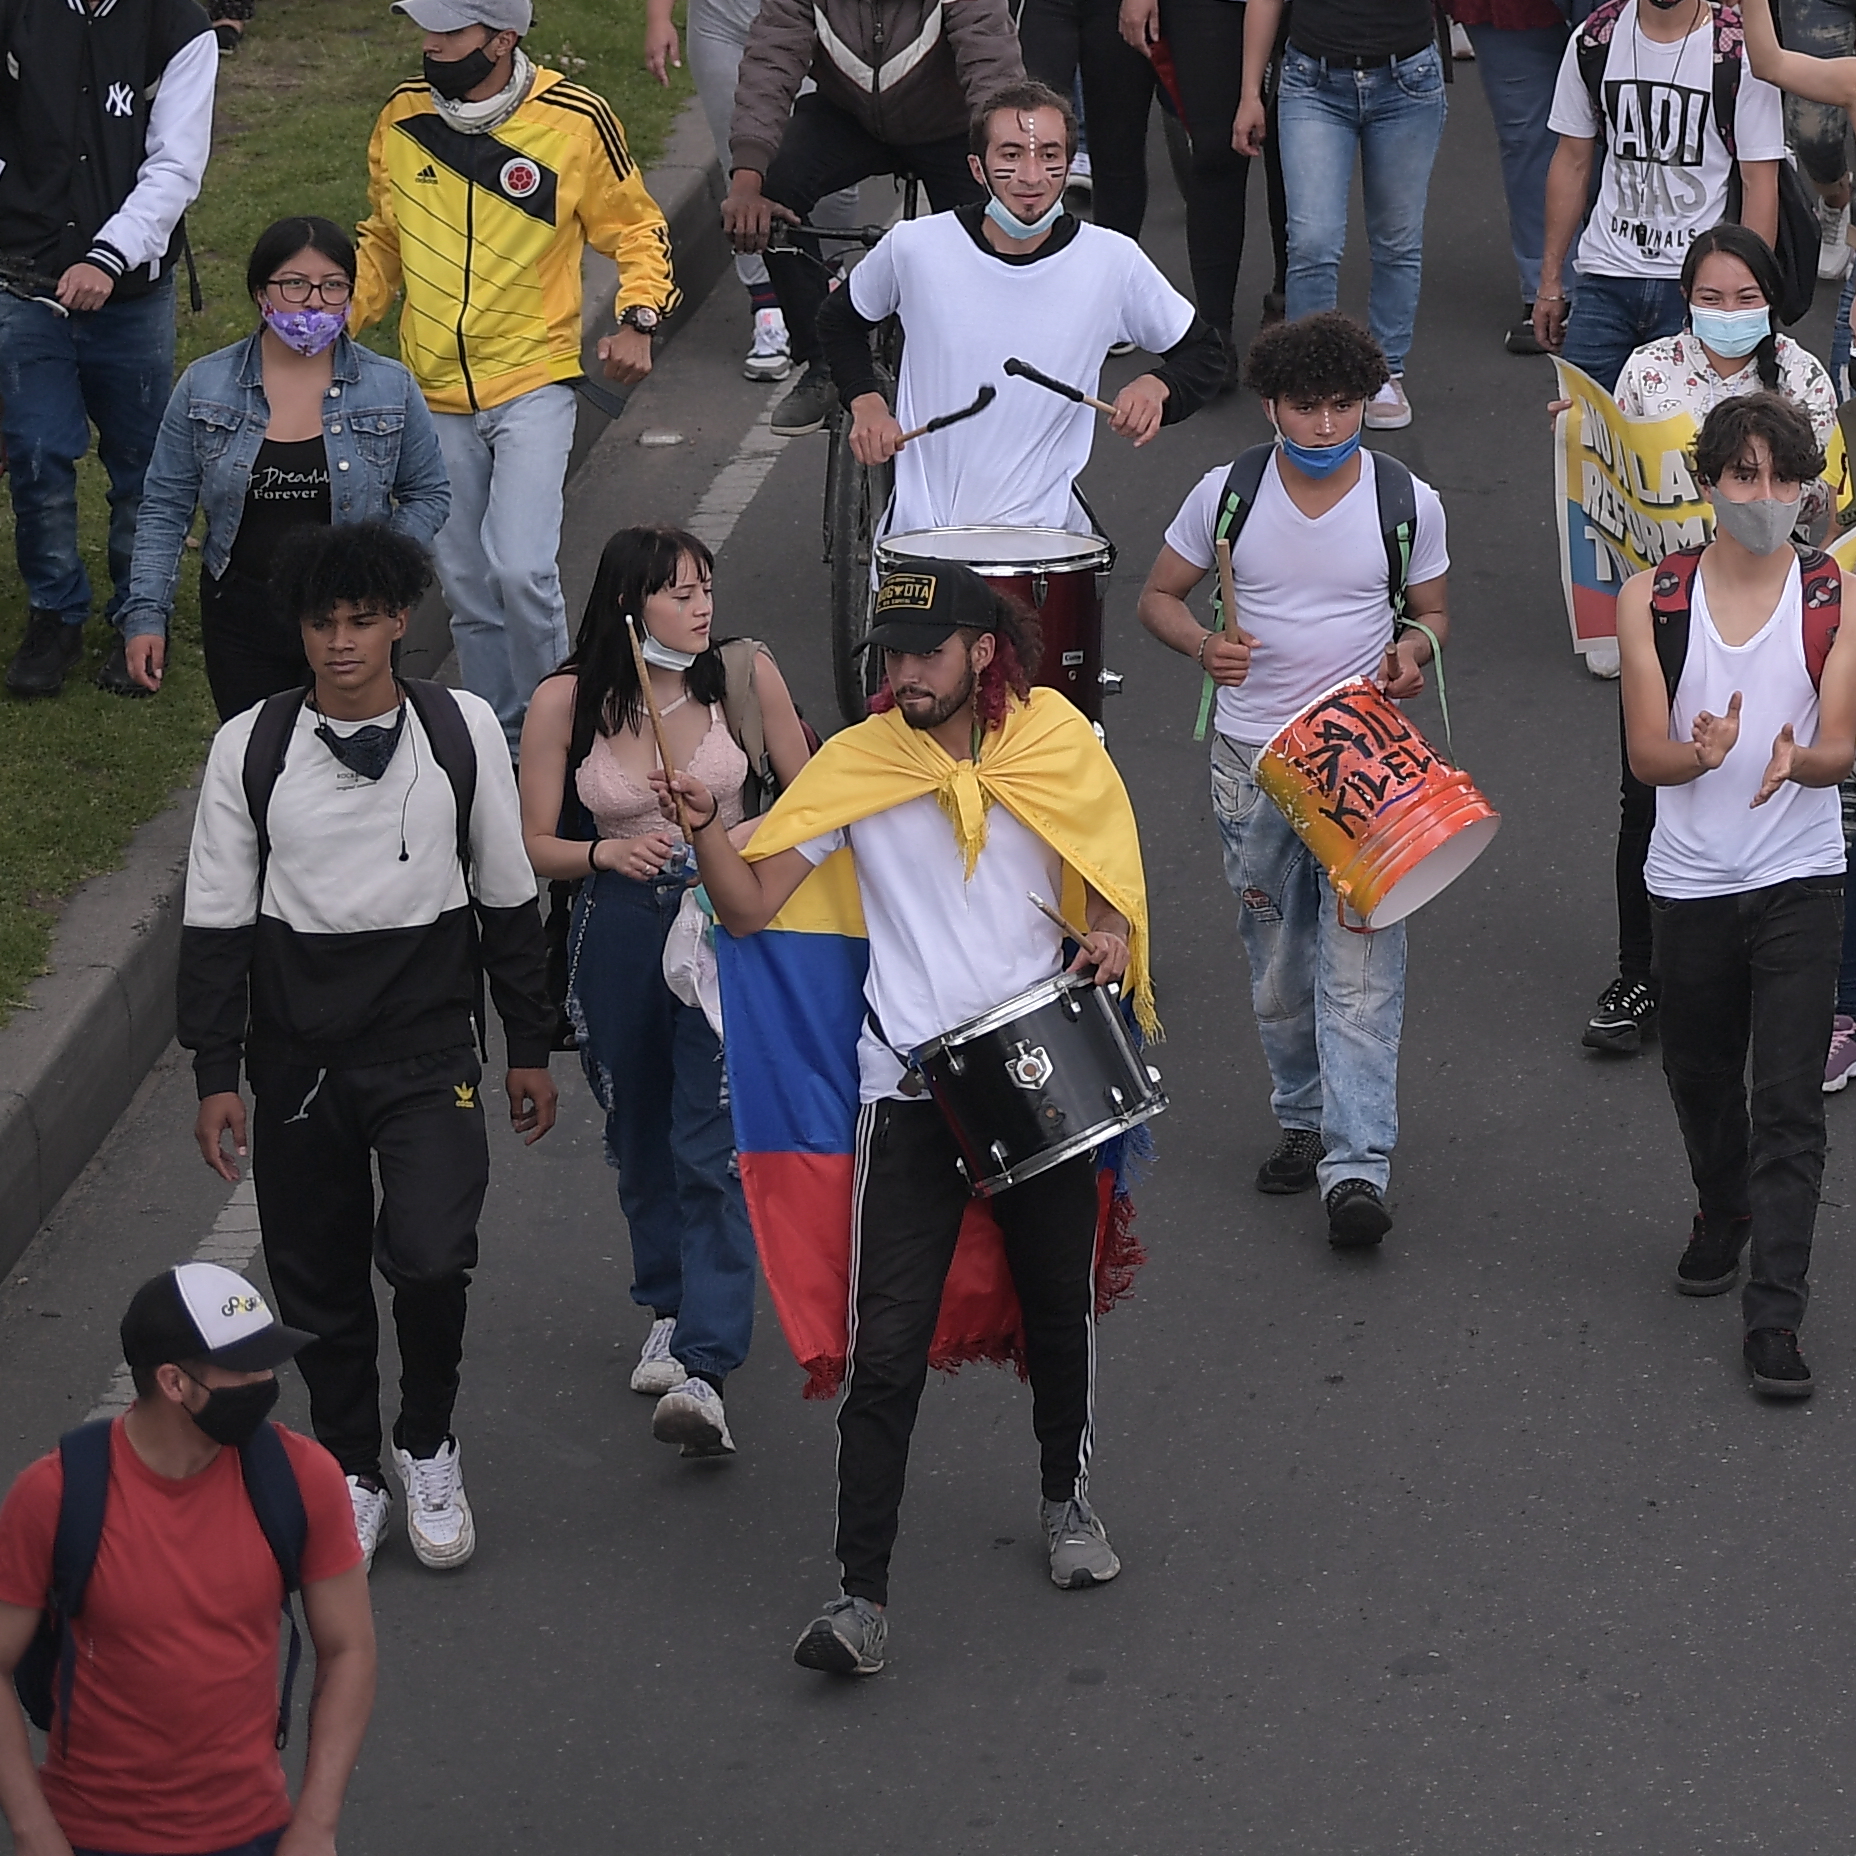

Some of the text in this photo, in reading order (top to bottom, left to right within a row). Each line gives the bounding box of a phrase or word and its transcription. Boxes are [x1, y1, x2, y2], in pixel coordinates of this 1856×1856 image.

[105, 81, 134, 117] NY
[1611, 214, 1699, 252] ORIINALS
[254, 487, 318, 500] Forever
[1630, 448, 1699, 504] LA
[1581, 459, 1716, 557] REFORM
